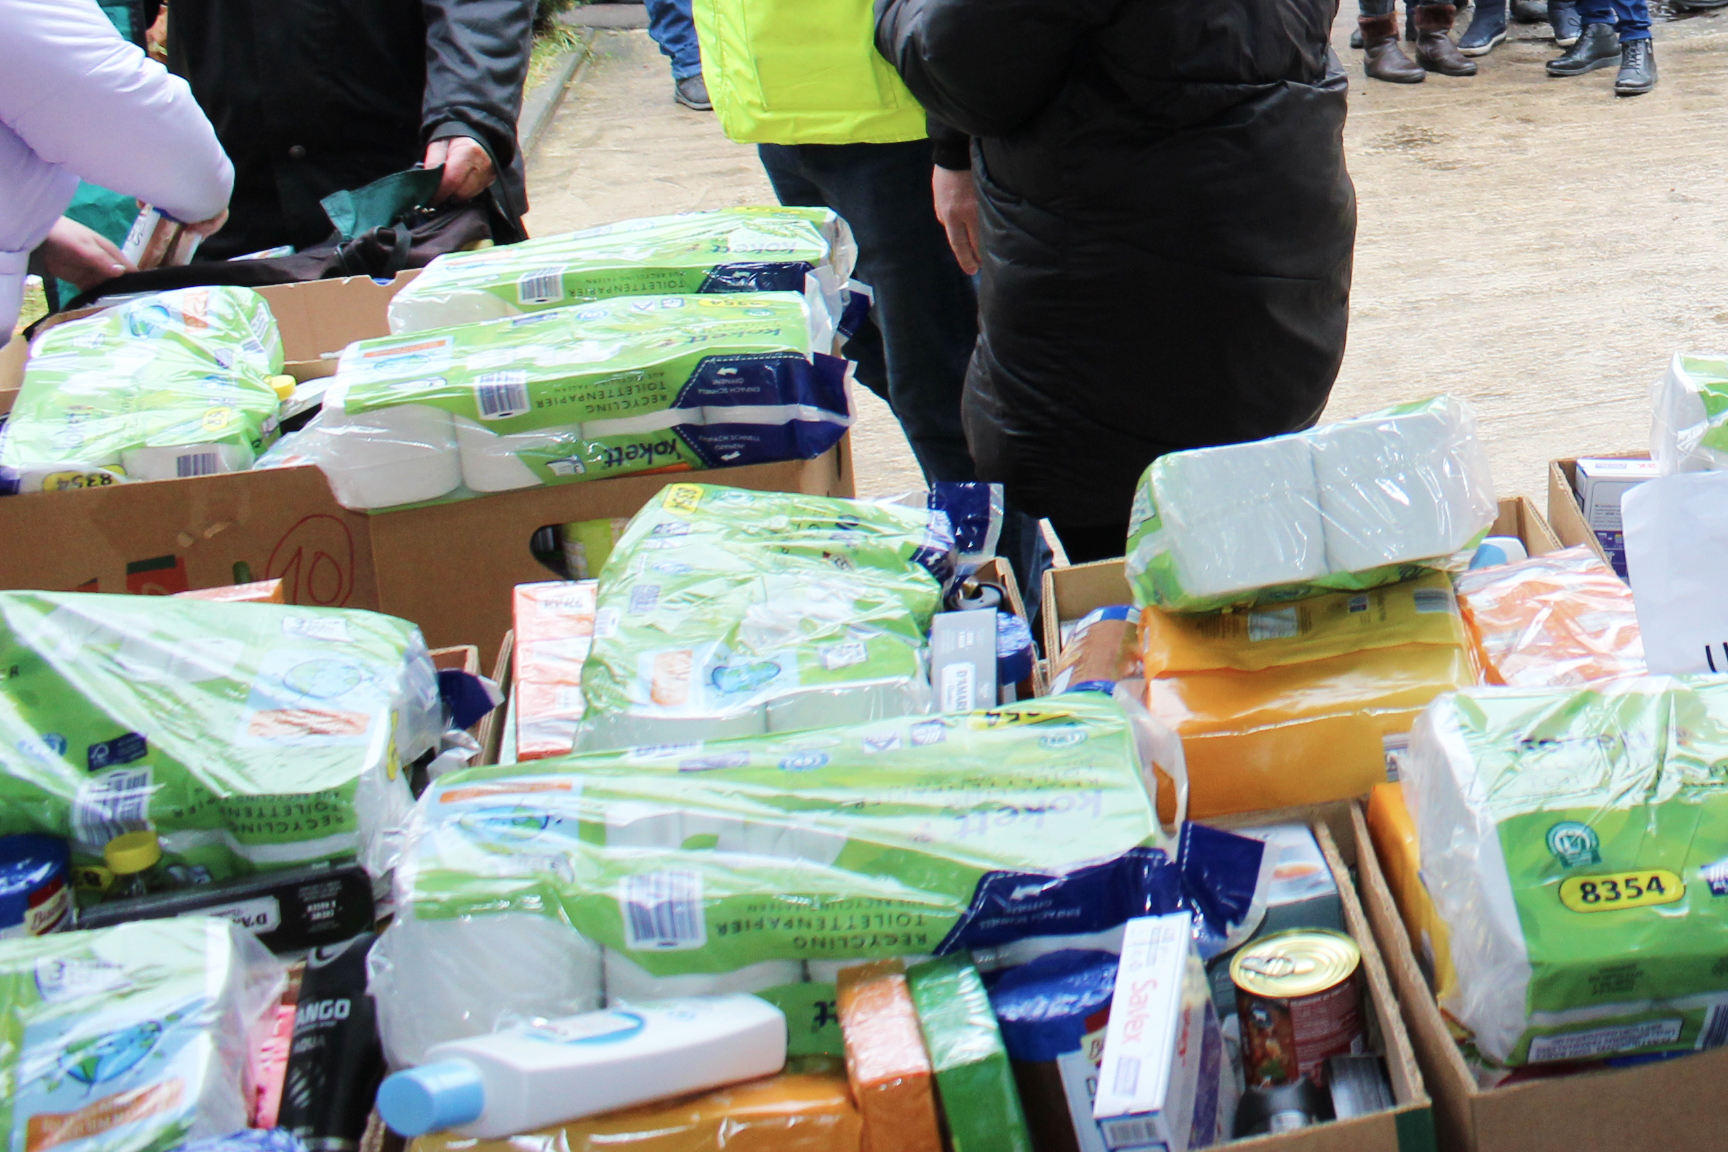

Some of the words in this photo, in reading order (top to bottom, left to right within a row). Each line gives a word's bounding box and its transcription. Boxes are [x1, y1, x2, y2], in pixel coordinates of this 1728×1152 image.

[567, 279, 686, 297] TOILETTENPAPIER
[534, 381, 668, 410] TOILETTENPAPIER
[586, 393, 668, 414] RECYCLING
[603, 437, 684, 469] kokett
[1578, 875, 1667, 905] 8354
[715, 913, 926, 938] TOILETTENPAPIER
[791, 932, 928, 949] RECYCLING
[295, 998, 352, 1028] ANGO
